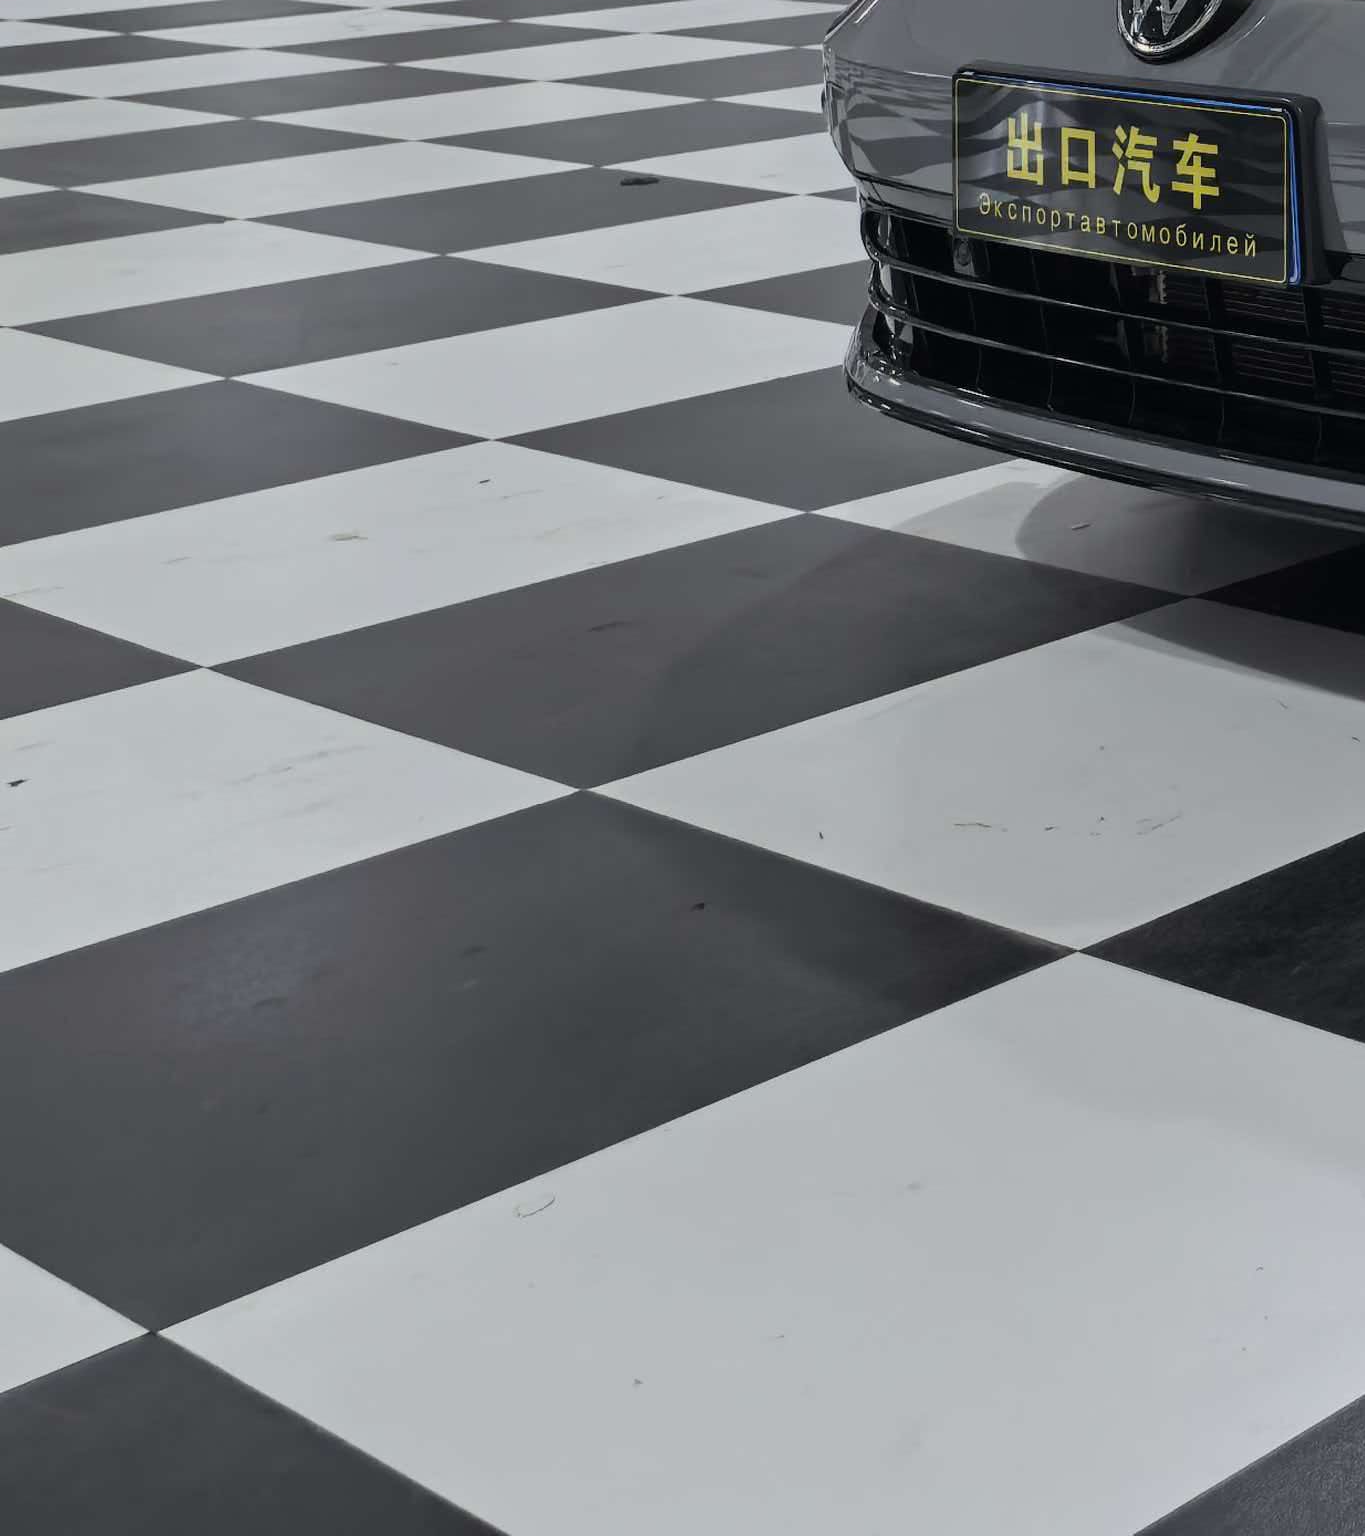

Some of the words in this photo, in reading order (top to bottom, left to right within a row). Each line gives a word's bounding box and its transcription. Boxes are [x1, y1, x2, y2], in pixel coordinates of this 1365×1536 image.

[1006, 112, 1220, 210] 出口汽车
[978, 192, 1257, 258] Экспортавтомобилей
